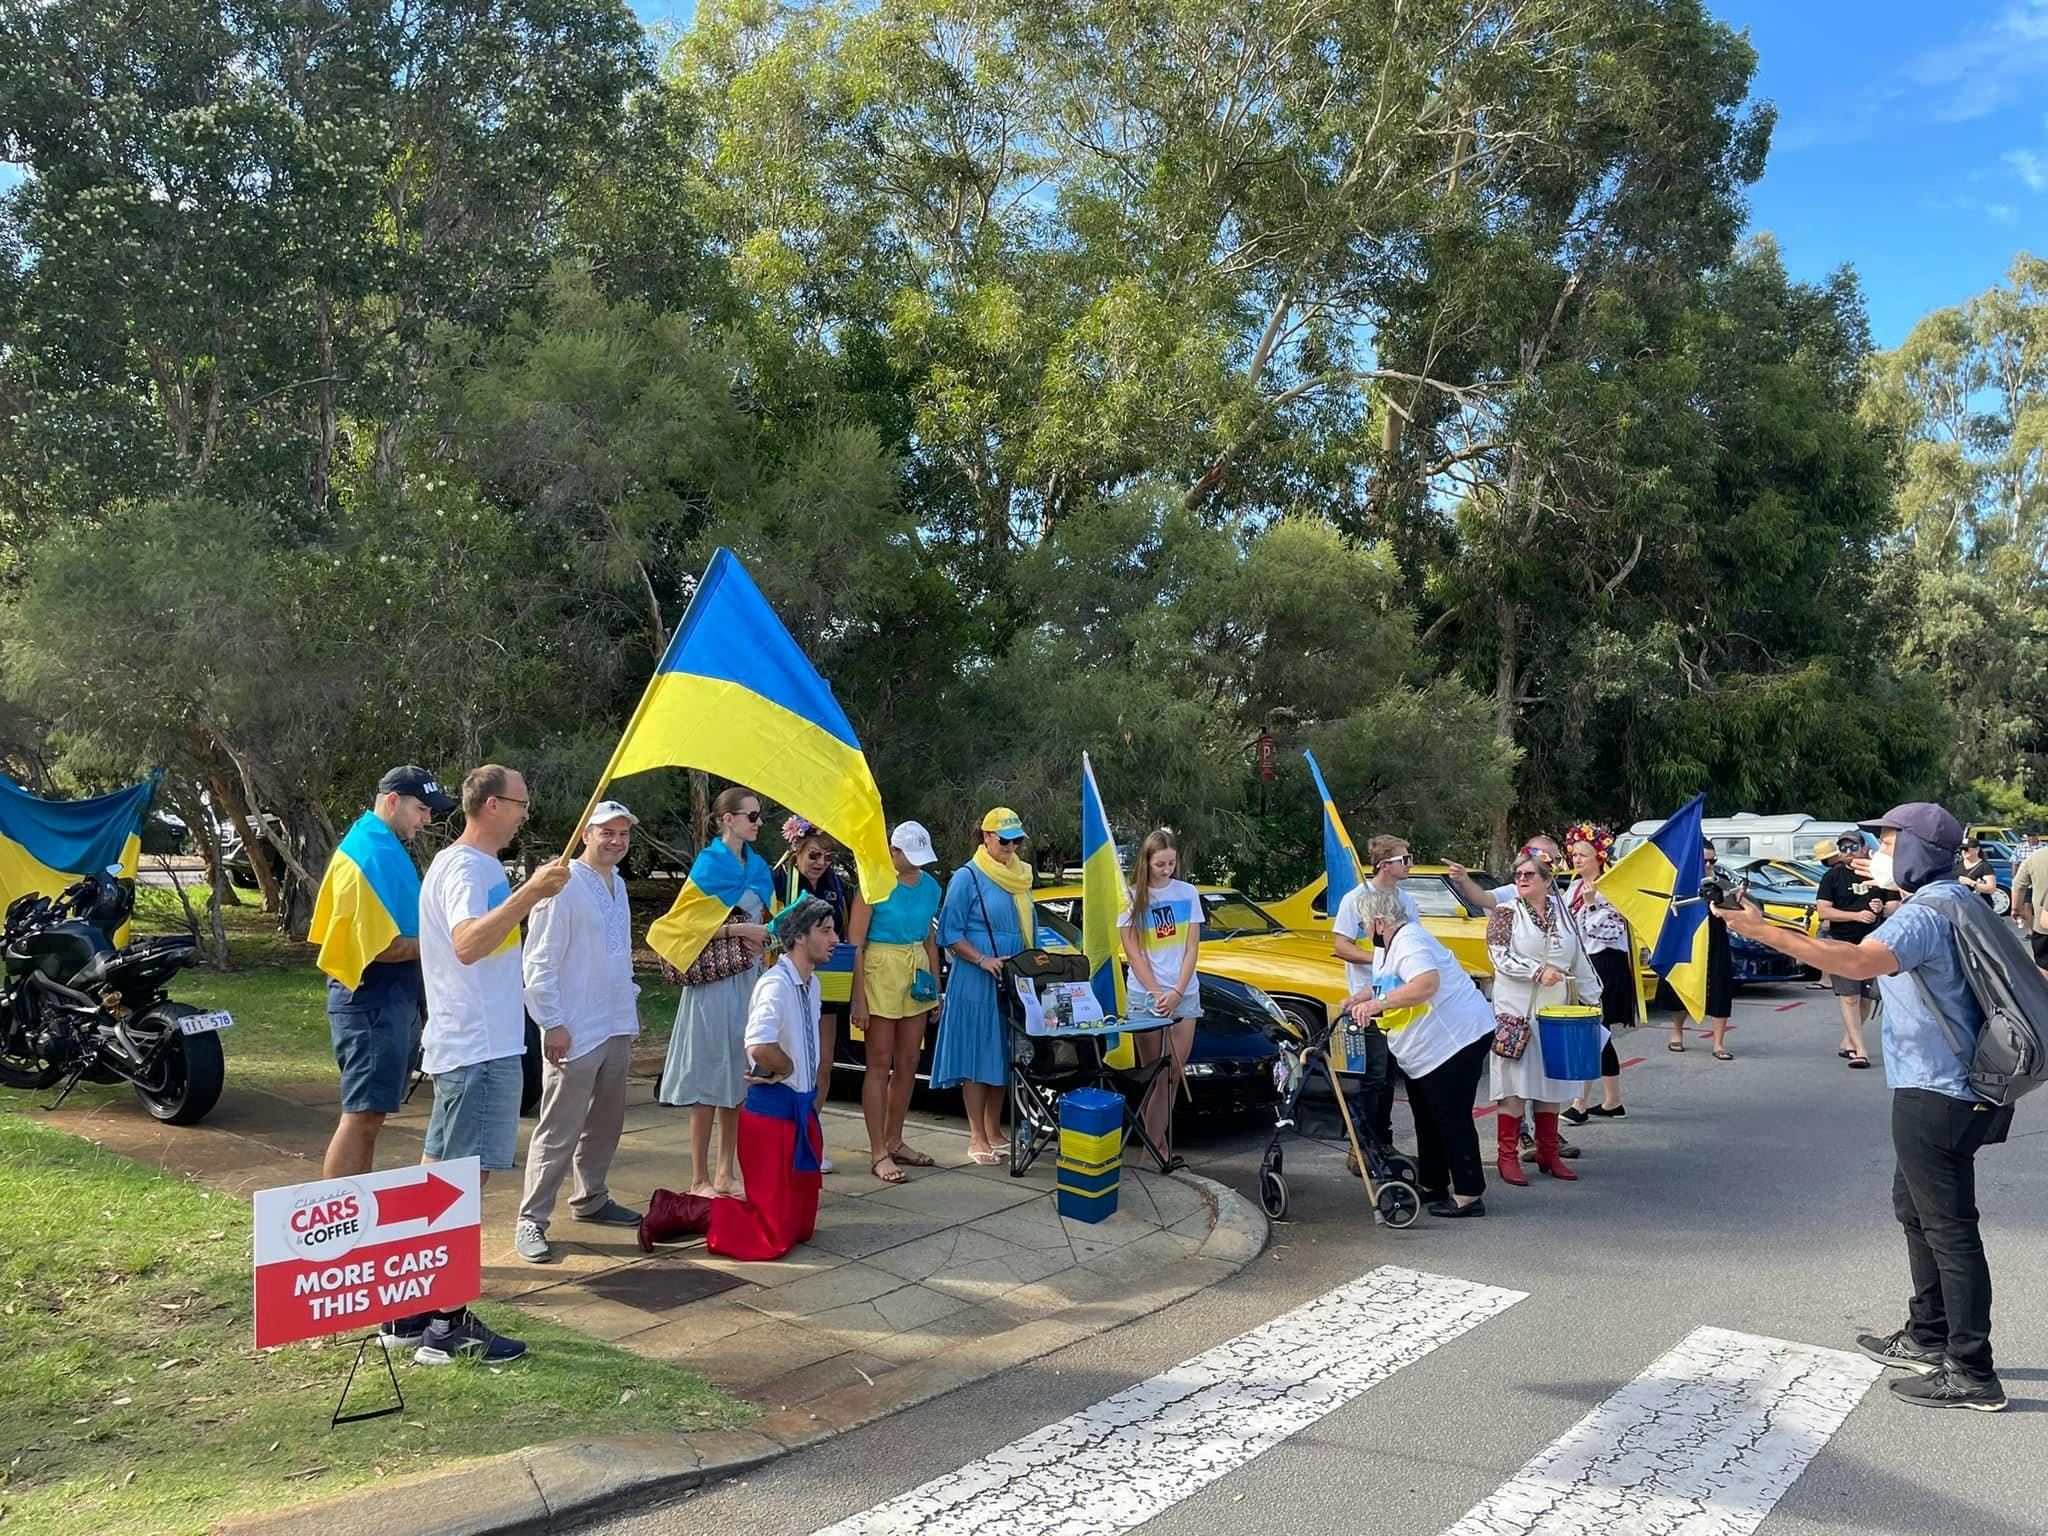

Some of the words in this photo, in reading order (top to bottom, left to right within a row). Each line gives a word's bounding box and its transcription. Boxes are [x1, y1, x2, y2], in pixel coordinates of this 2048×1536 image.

[210, 1015, 231, 1027] 578
[291, 1195, 360, 1232] CARS
[304, 1219, 359, 1246] COFFEE
[294, 1261, 375, 1296] MORE
[384, 1246, 448, 1277] CARS
[309, 1290, 370, 1321] THIS
[378, 1274, 436, 1306] WAY
